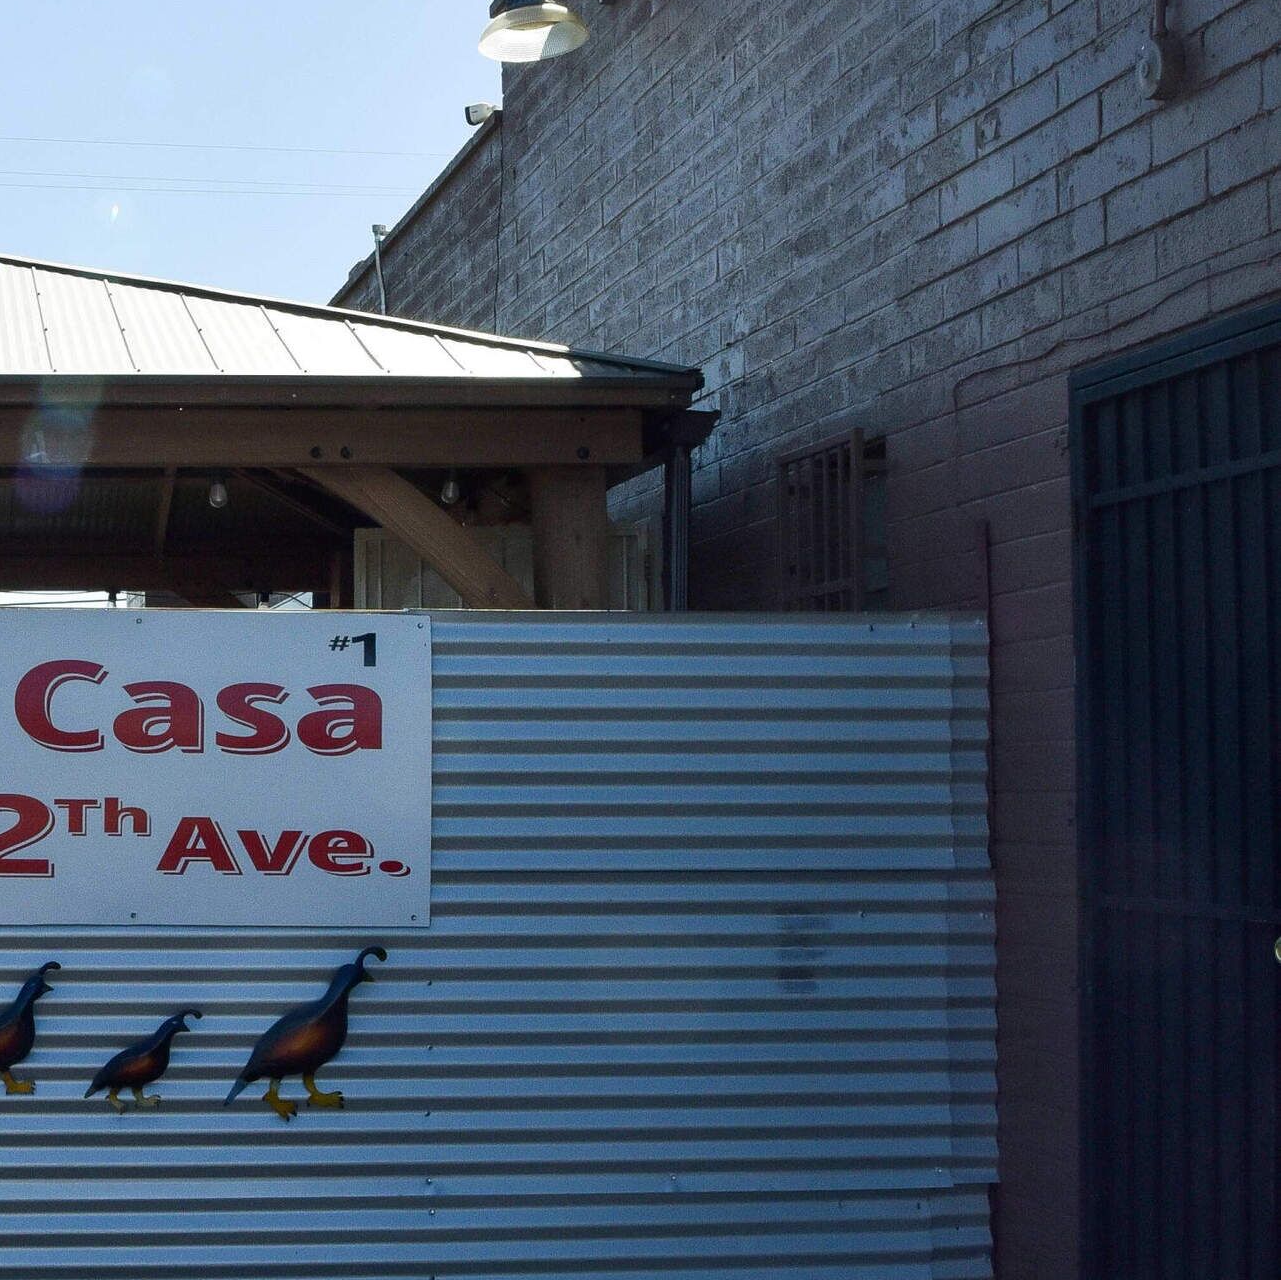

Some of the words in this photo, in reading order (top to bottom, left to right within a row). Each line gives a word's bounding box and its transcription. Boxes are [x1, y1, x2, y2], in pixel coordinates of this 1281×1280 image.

[328, 632, 377, 667] #1
[14, 658, 383, 756] Casa
[156, 816, 411, 877] Ave.
